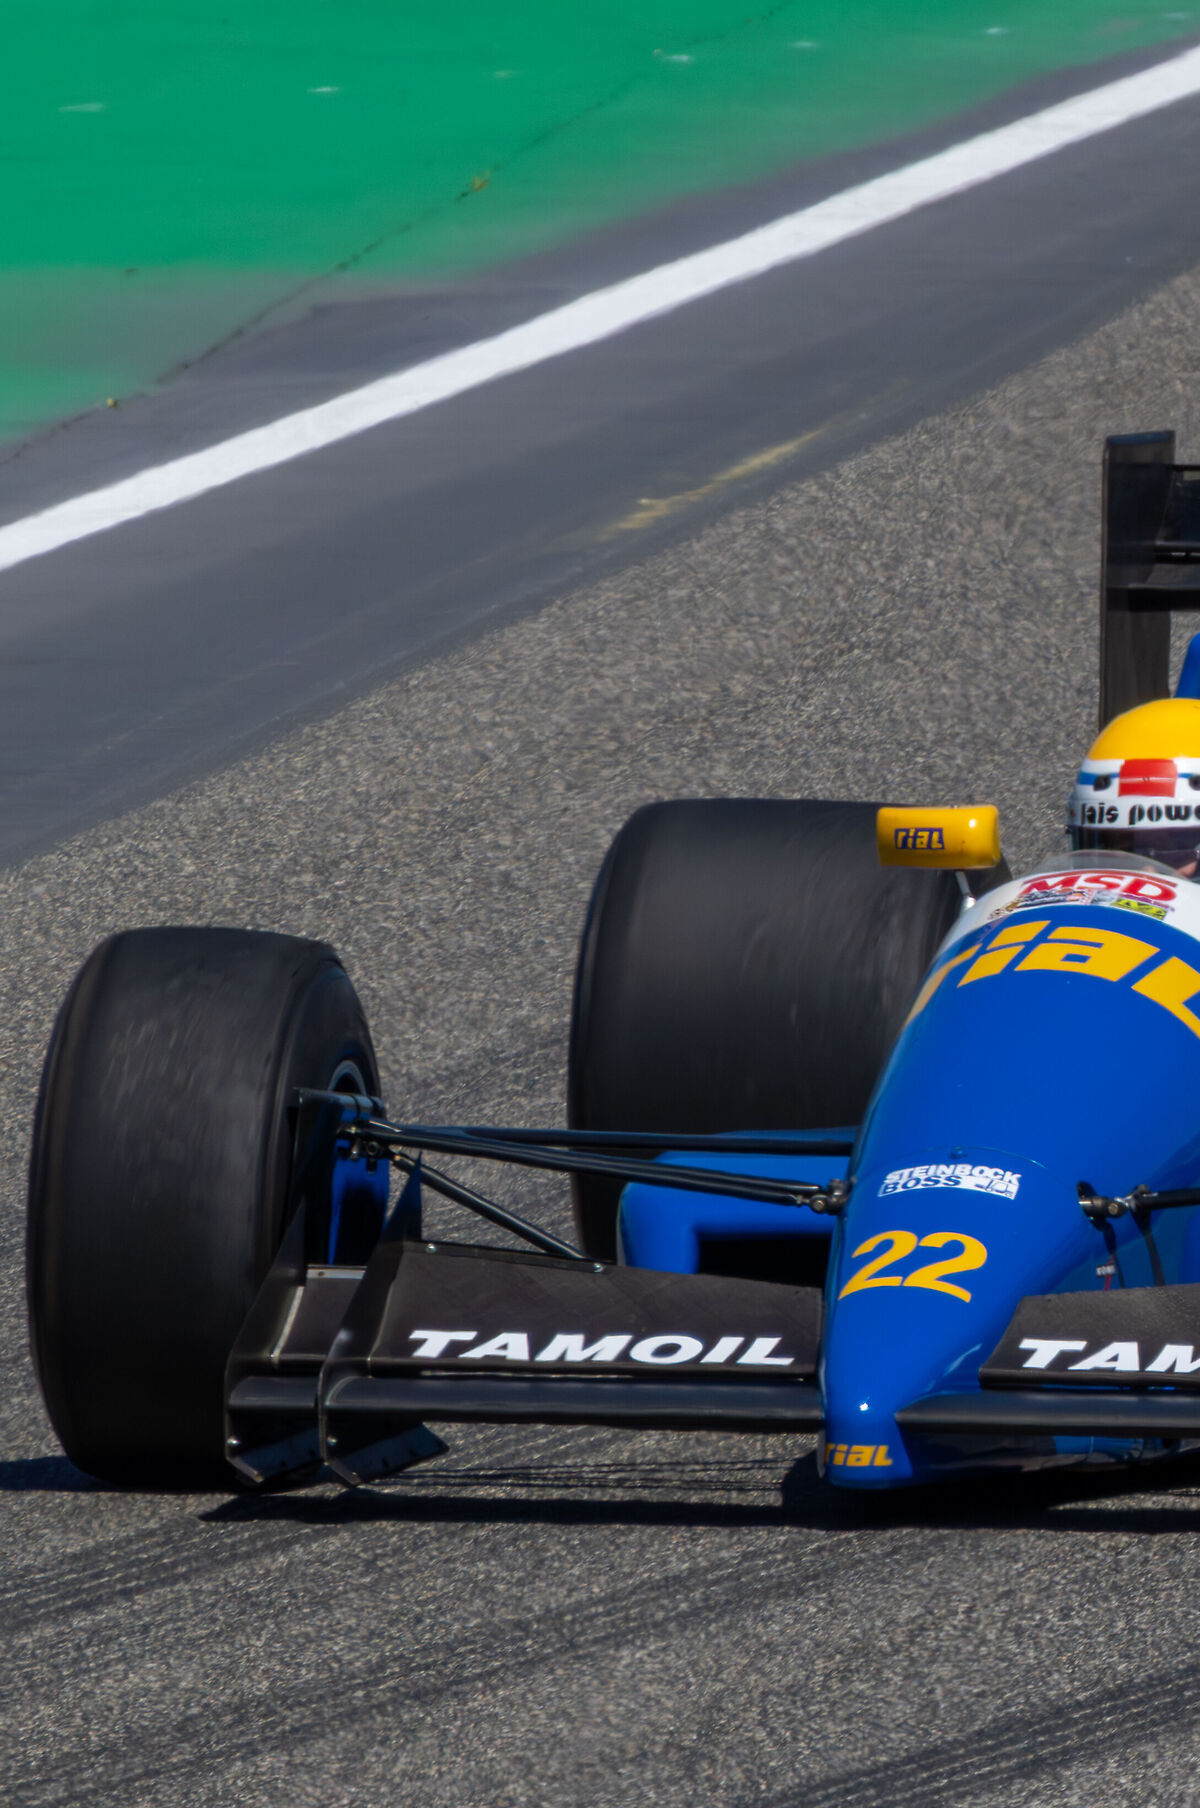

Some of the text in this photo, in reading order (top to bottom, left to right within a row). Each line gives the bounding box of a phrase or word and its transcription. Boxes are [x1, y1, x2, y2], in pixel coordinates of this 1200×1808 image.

[1018, 873, 1176, 902] MSD
[883, 1175, 963, 1195] BOSS
[884, 1164, 1022, 1185] STEINBOCK
[839, 1230, 987, 1302] 22
[408, 1329, 795, 1366] TAMOIL
